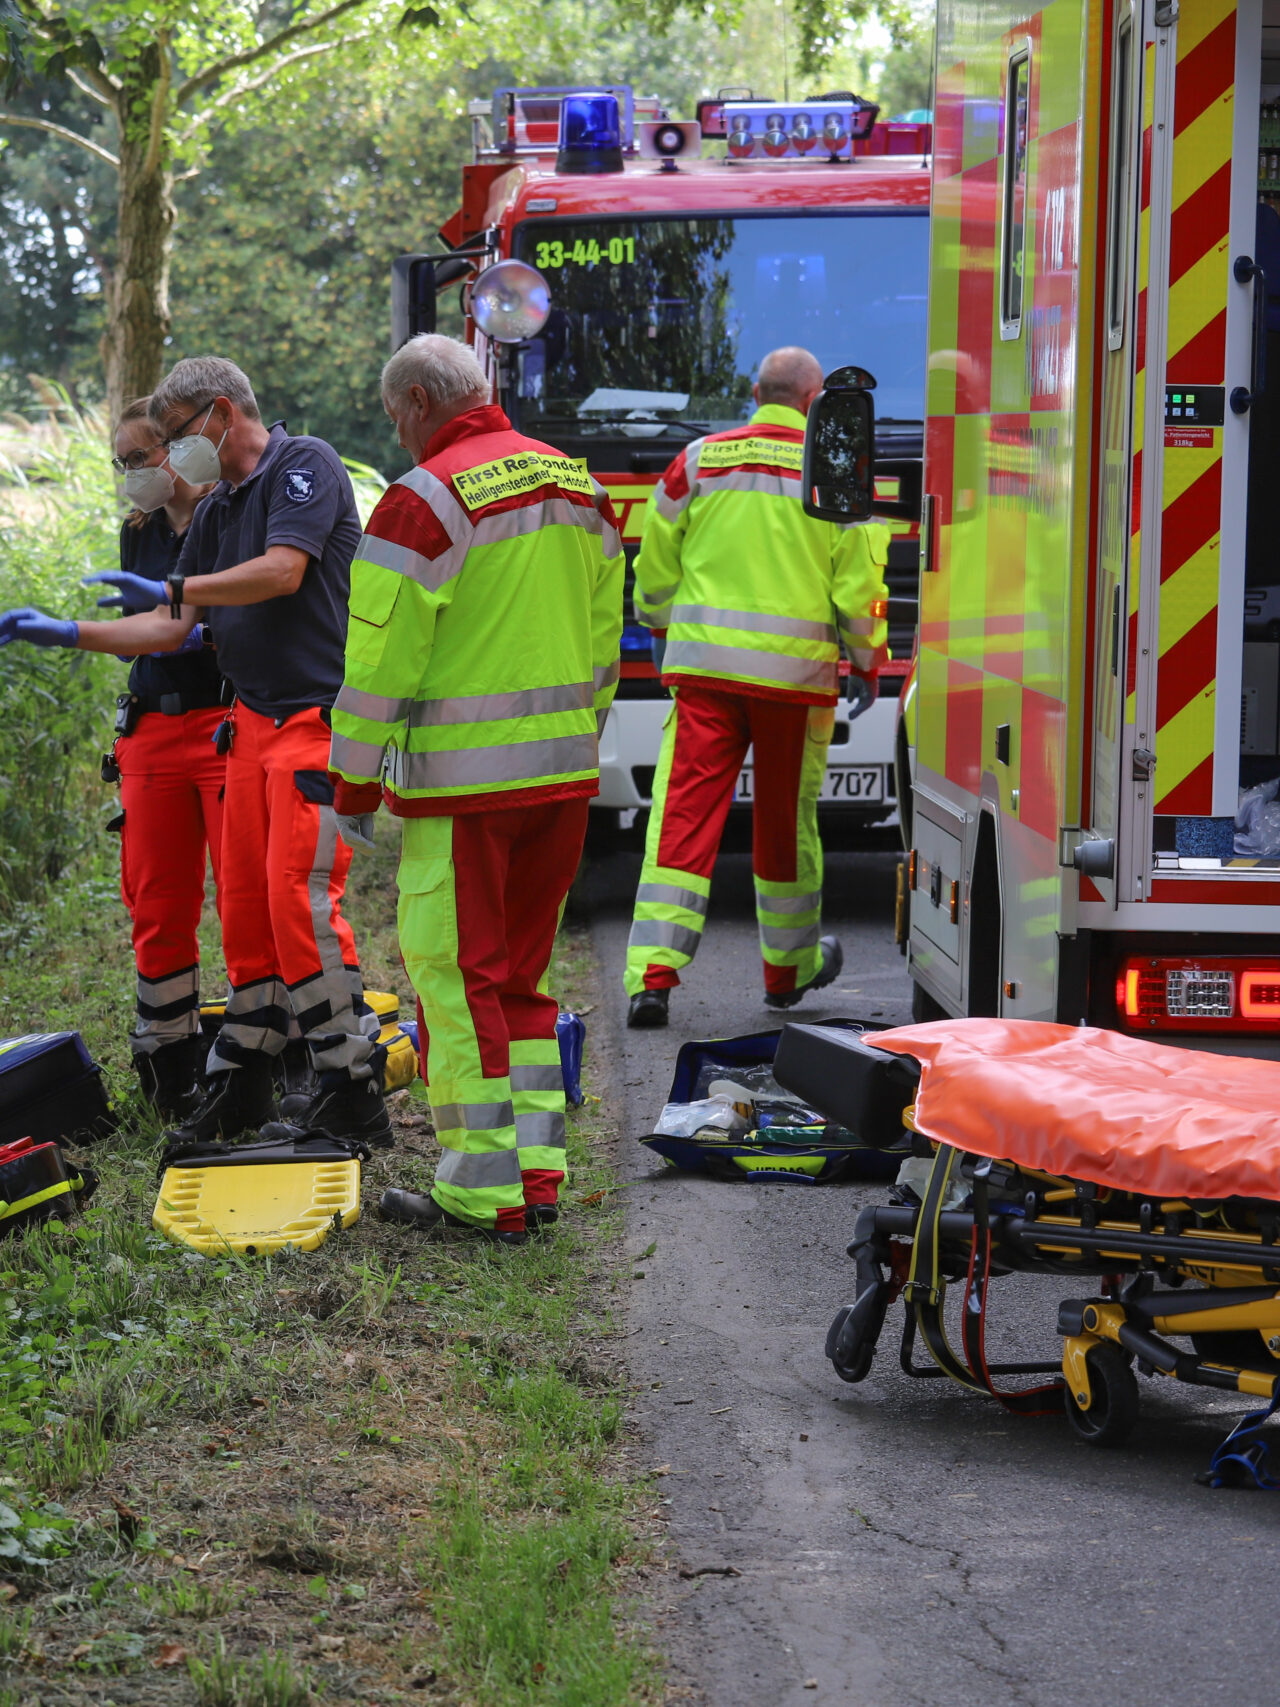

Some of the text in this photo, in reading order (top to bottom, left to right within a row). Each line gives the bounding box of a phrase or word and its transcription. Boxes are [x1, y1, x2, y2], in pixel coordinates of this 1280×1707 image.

[536, 237, 635, 269] 33-44-01
[704, 443, 740, 453] First
[455, 465, 502, 490] First
[830, 771, 878, 797] 707
